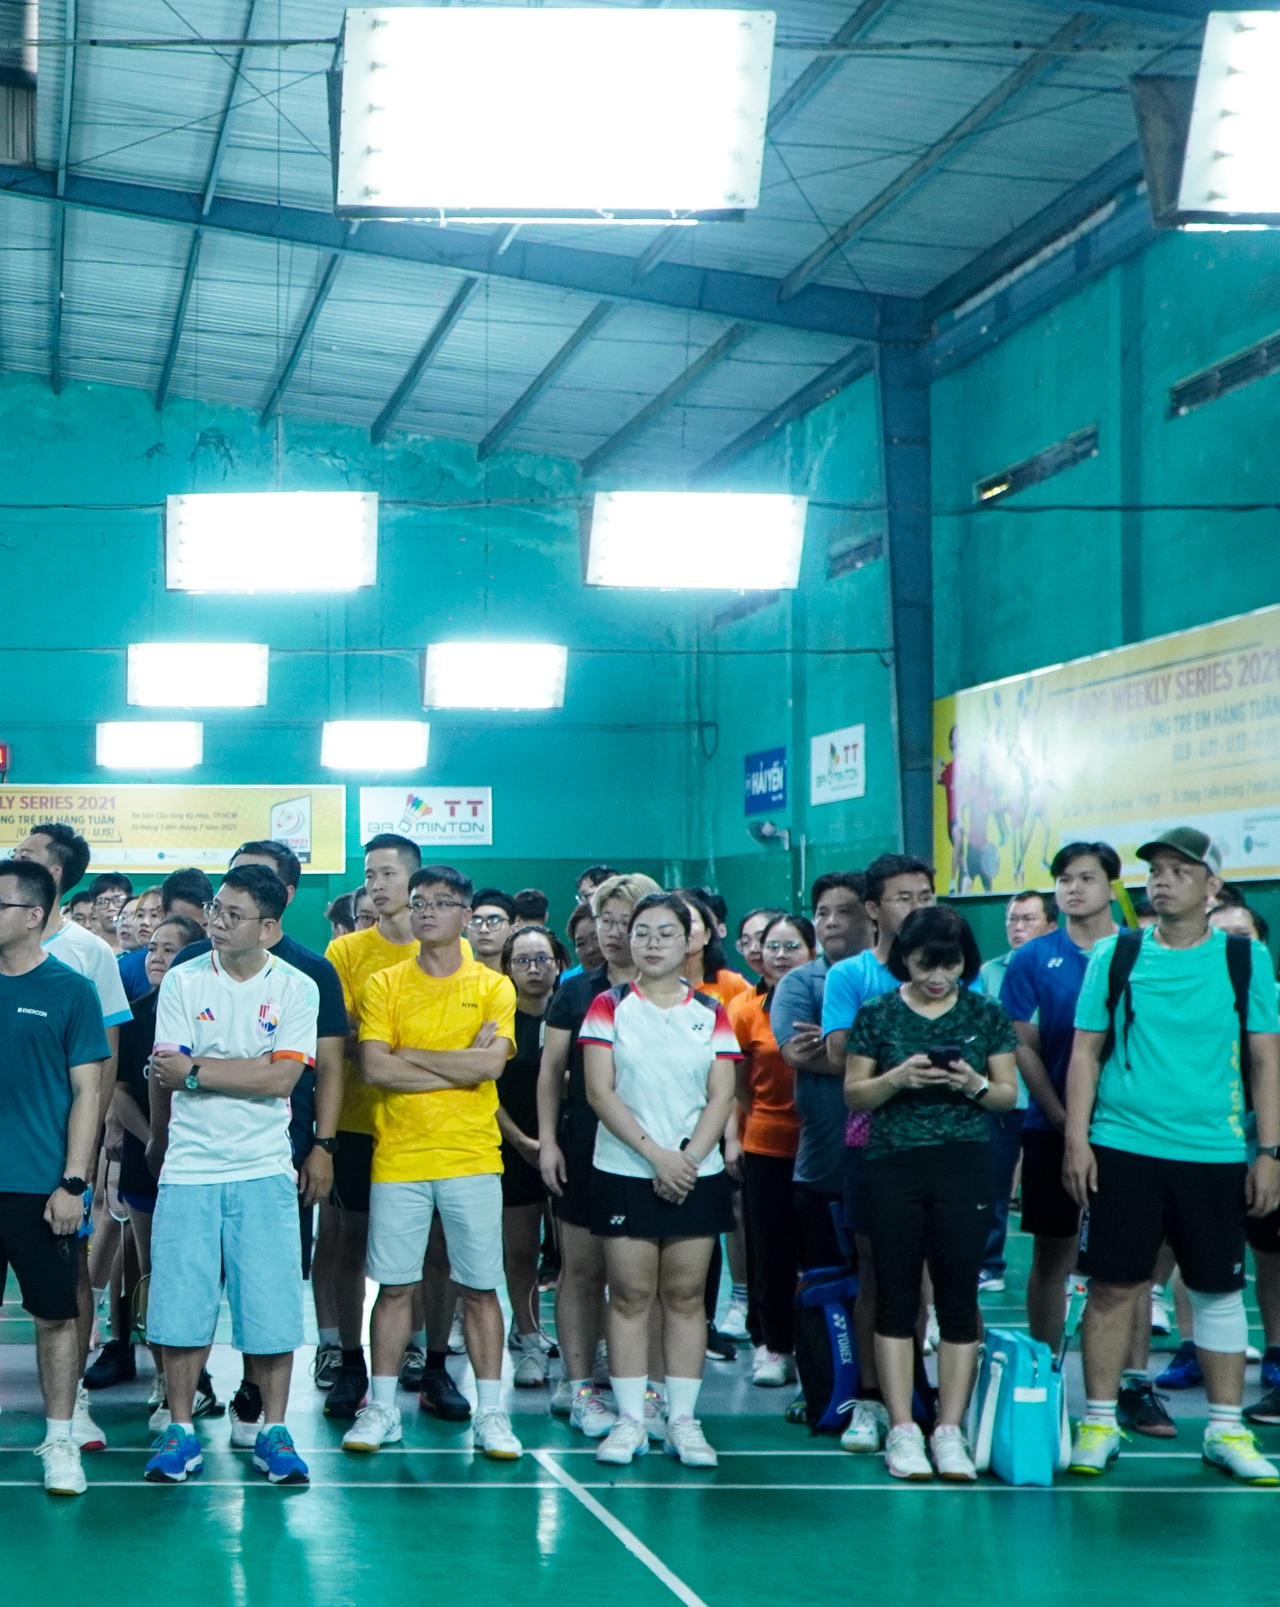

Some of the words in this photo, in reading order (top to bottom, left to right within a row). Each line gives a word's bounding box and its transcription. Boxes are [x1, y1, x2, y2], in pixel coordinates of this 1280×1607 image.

[1112, 673, 1172, 715] WEEKLY
[1175, 659, 1233, 702] SERIES
[843, 743, 858, 765] TT
[19, 795, 73, 810] SERIES
[77, 795, 116, 810] 2021
[444, 800, 484, 817] TT
[39, 815, 53, 824] EM
[368, 820, 484, 833] BADMINTON
[836, 1331, 853, 1365] YONEX
